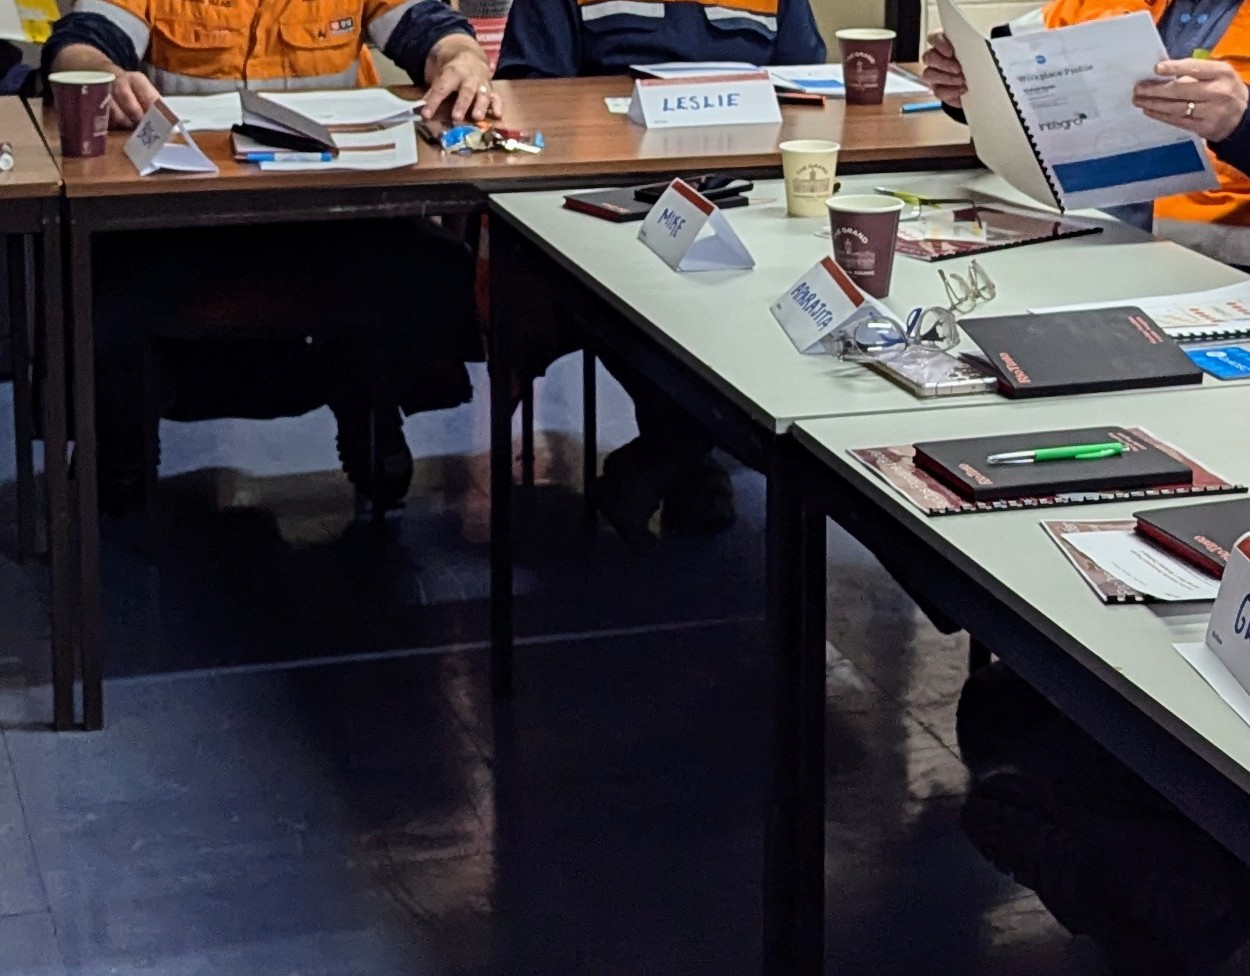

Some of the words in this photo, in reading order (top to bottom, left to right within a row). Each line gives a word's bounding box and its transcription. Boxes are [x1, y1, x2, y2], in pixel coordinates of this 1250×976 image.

[662, 92, 741, 113] LESLIE
[657, 207, 687, 238] MIKE
[841, 226, 868, 244] GRAND
[790, 281, 833, 332] APARAJITA
